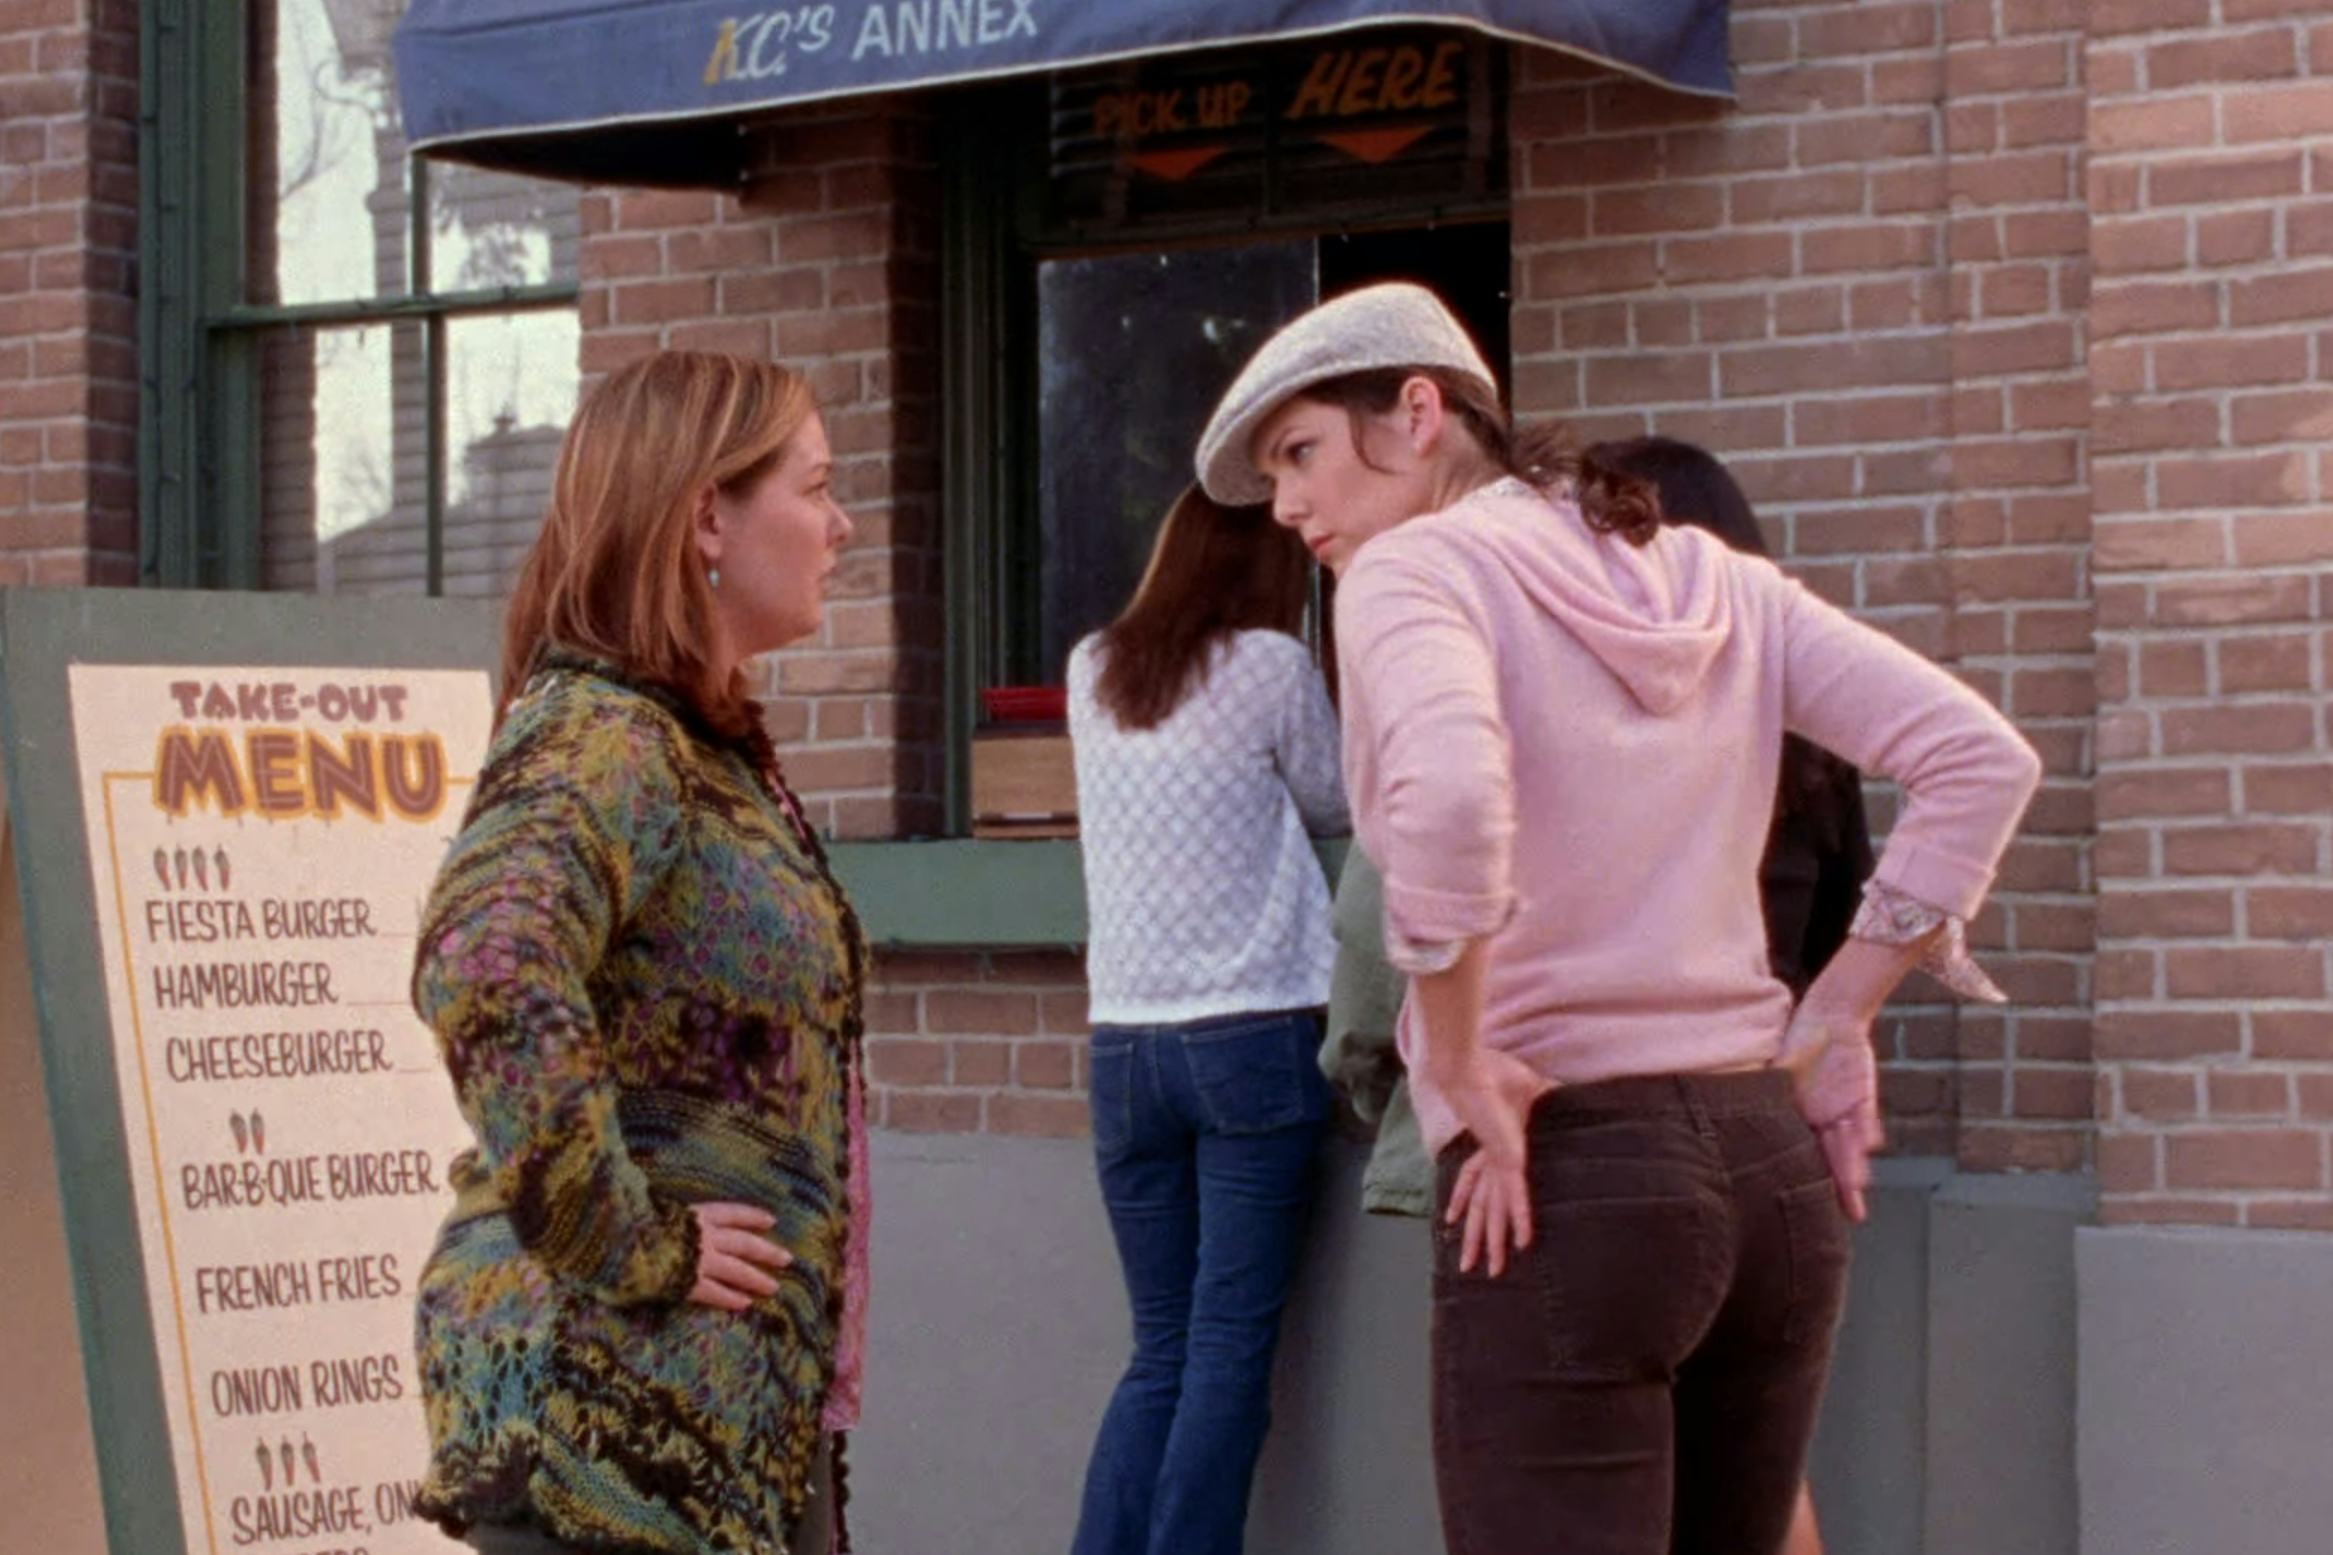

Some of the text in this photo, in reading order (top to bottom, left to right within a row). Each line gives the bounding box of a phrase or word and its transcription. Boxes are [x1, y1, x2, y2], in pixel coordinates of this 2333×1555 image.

[851, 0, 1038, 61] ANNEX
[1092, 40, 1464, 136] PICK UP HERE
[170, 681, 408, 722] TAKE-OUT
[154, 728, 449, 821] MENU
[145, 899, 378, 943] FIESTA BURGER
[153, 961, 340, 1009] HAMBURGER
[166, 1030, 393, 1083] CHEESEBURGER
[327, 1149, 440, 1201] BURGER
[195, 1253, 402, 1314] FRENCH FRIES
[211, 1354, 404, 1418] ONION RINGS
[230, 1486, 373, 1546] SAUSAGE,
